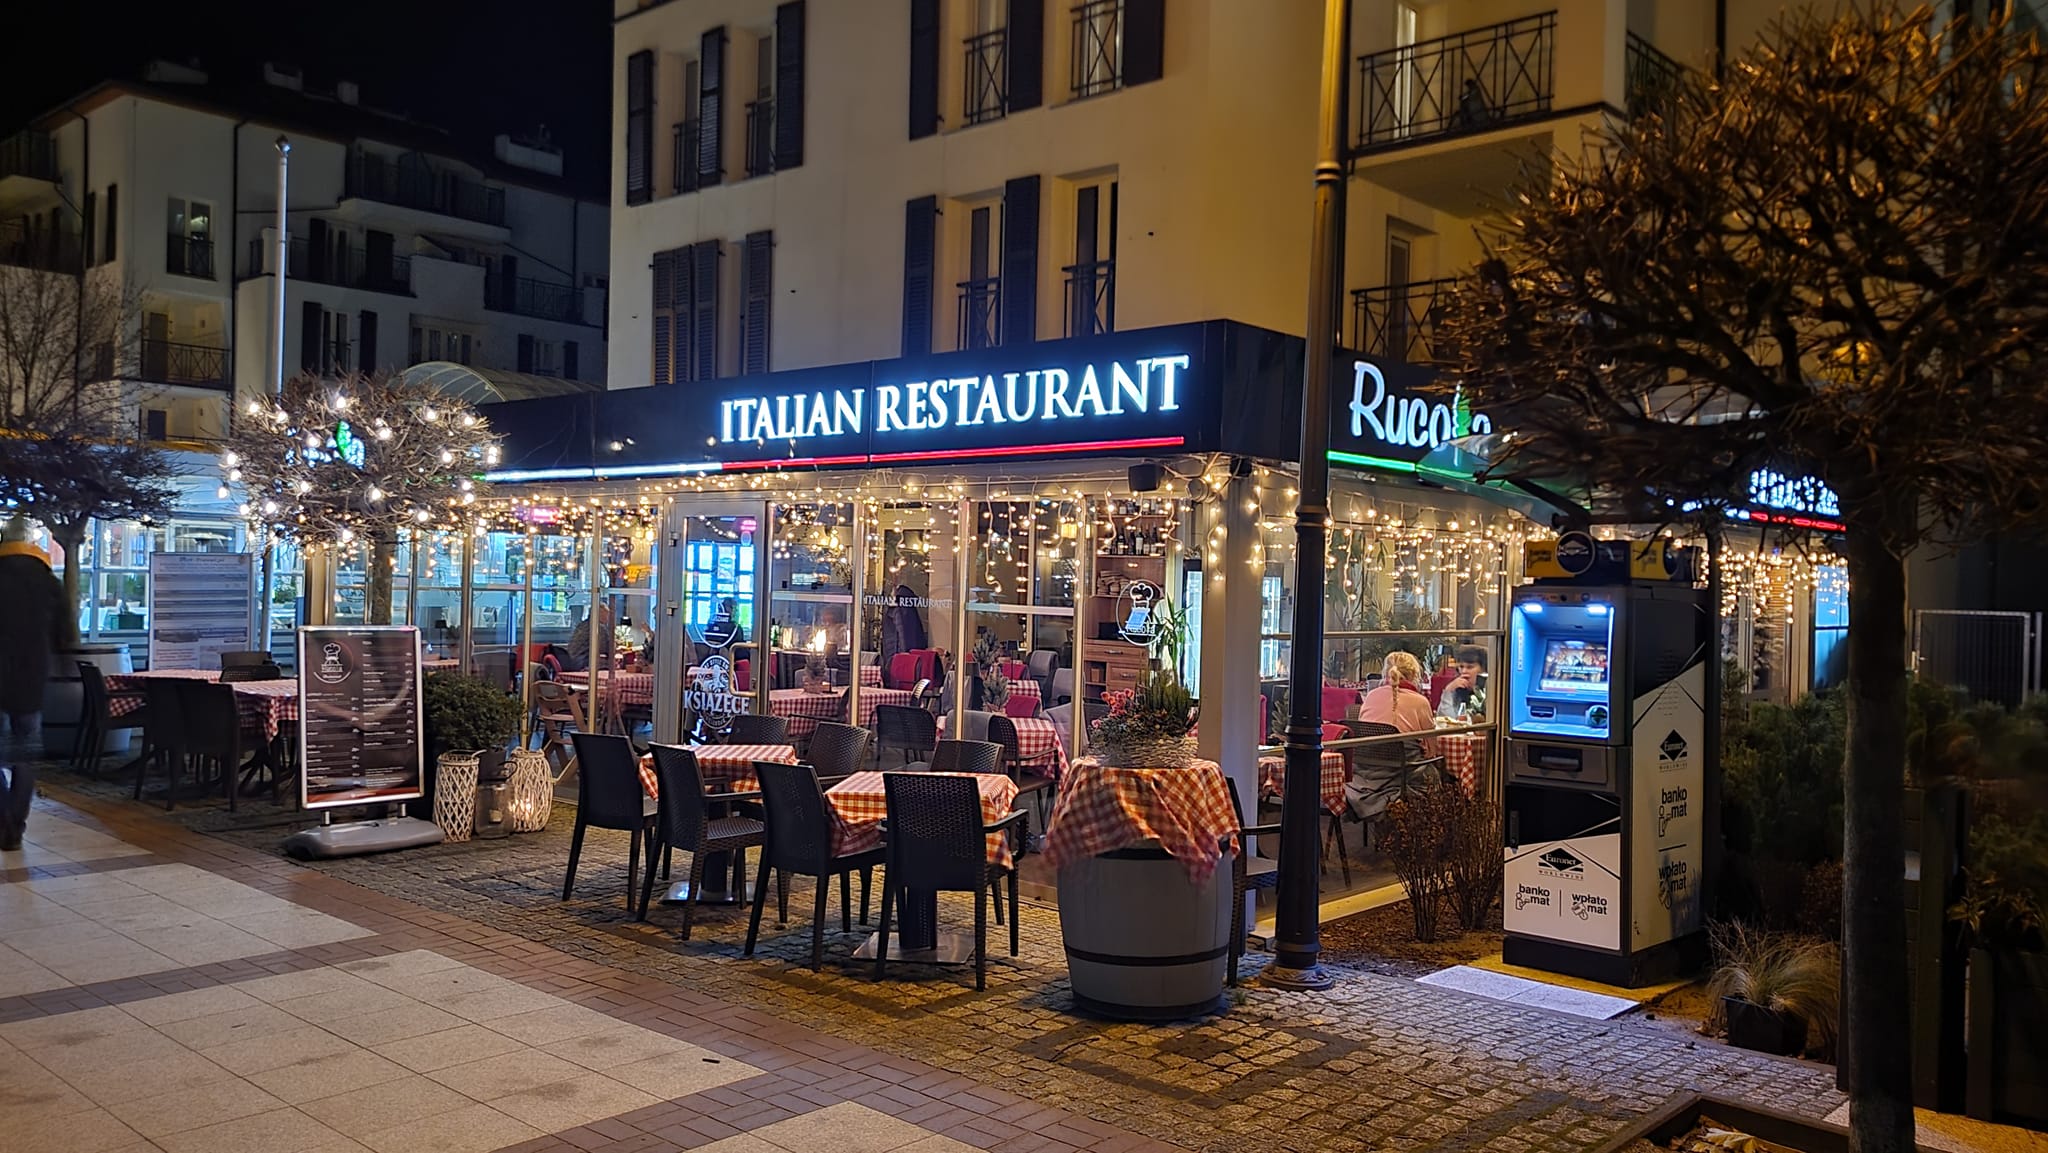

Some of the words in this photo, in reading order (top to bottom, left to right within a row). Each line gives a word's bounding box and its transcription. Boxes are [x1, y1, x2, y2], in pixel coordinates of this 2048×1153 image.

[720, 388, 865, 443] ITALIAN
[876, 354, 1190, 433] RESTAURANT
[1661, 786, 1687, 805] banko
[1671, 803, 1687, 819] mat
[1545, 853, 1577, 866] Euronet
[1519, 883, 1551, 897] banko
[1671, 876, 1687, 893] mat
[1530, 894, 1550, 907] mat
[1572, 893, 1608, 906] wpłato
[1587, 905, 1608, 916] mat
